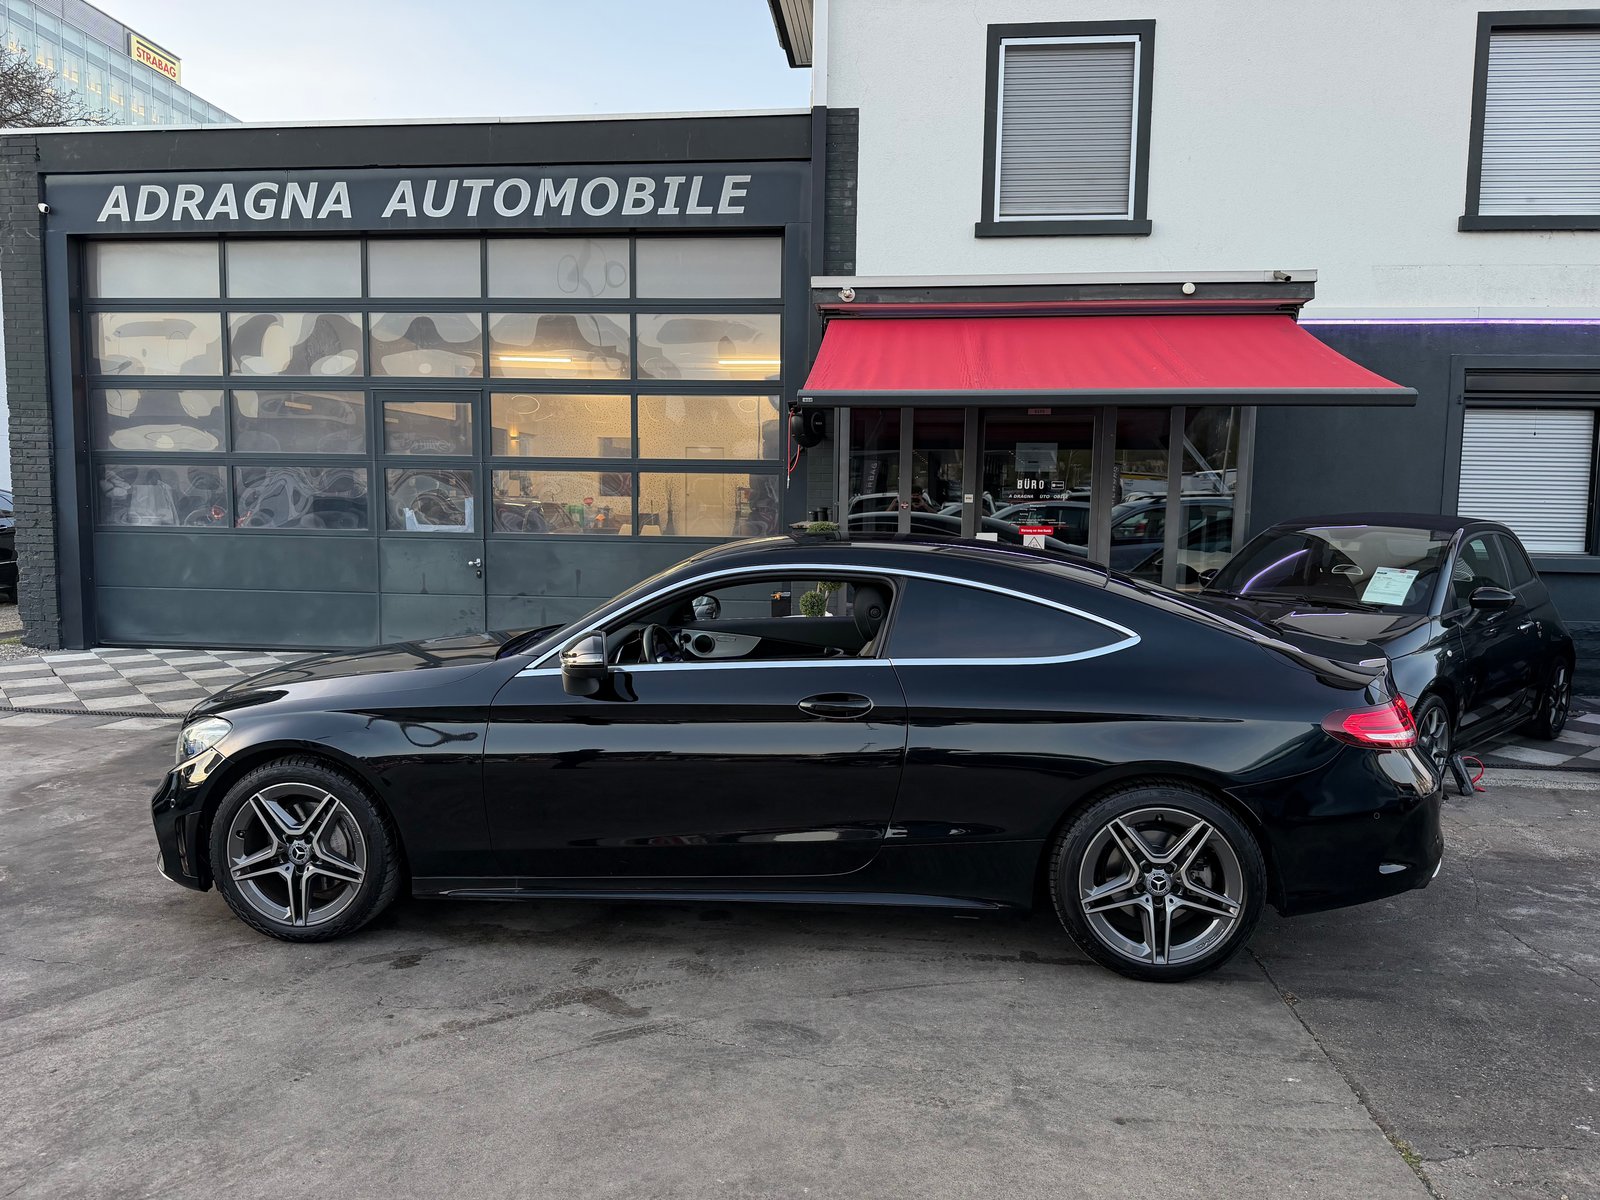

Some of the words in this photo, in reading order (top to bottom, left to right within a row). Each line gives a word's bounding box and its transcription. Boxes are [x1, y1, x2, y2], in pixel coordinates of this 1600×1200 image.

[136, 46, 177, 78] STRABAG
[97, 181, 353, 222] ADRAGNA
[381, 174, 752, 219] AUTOMOBILE
[1016, 478, 1045, 490] BÜRO
